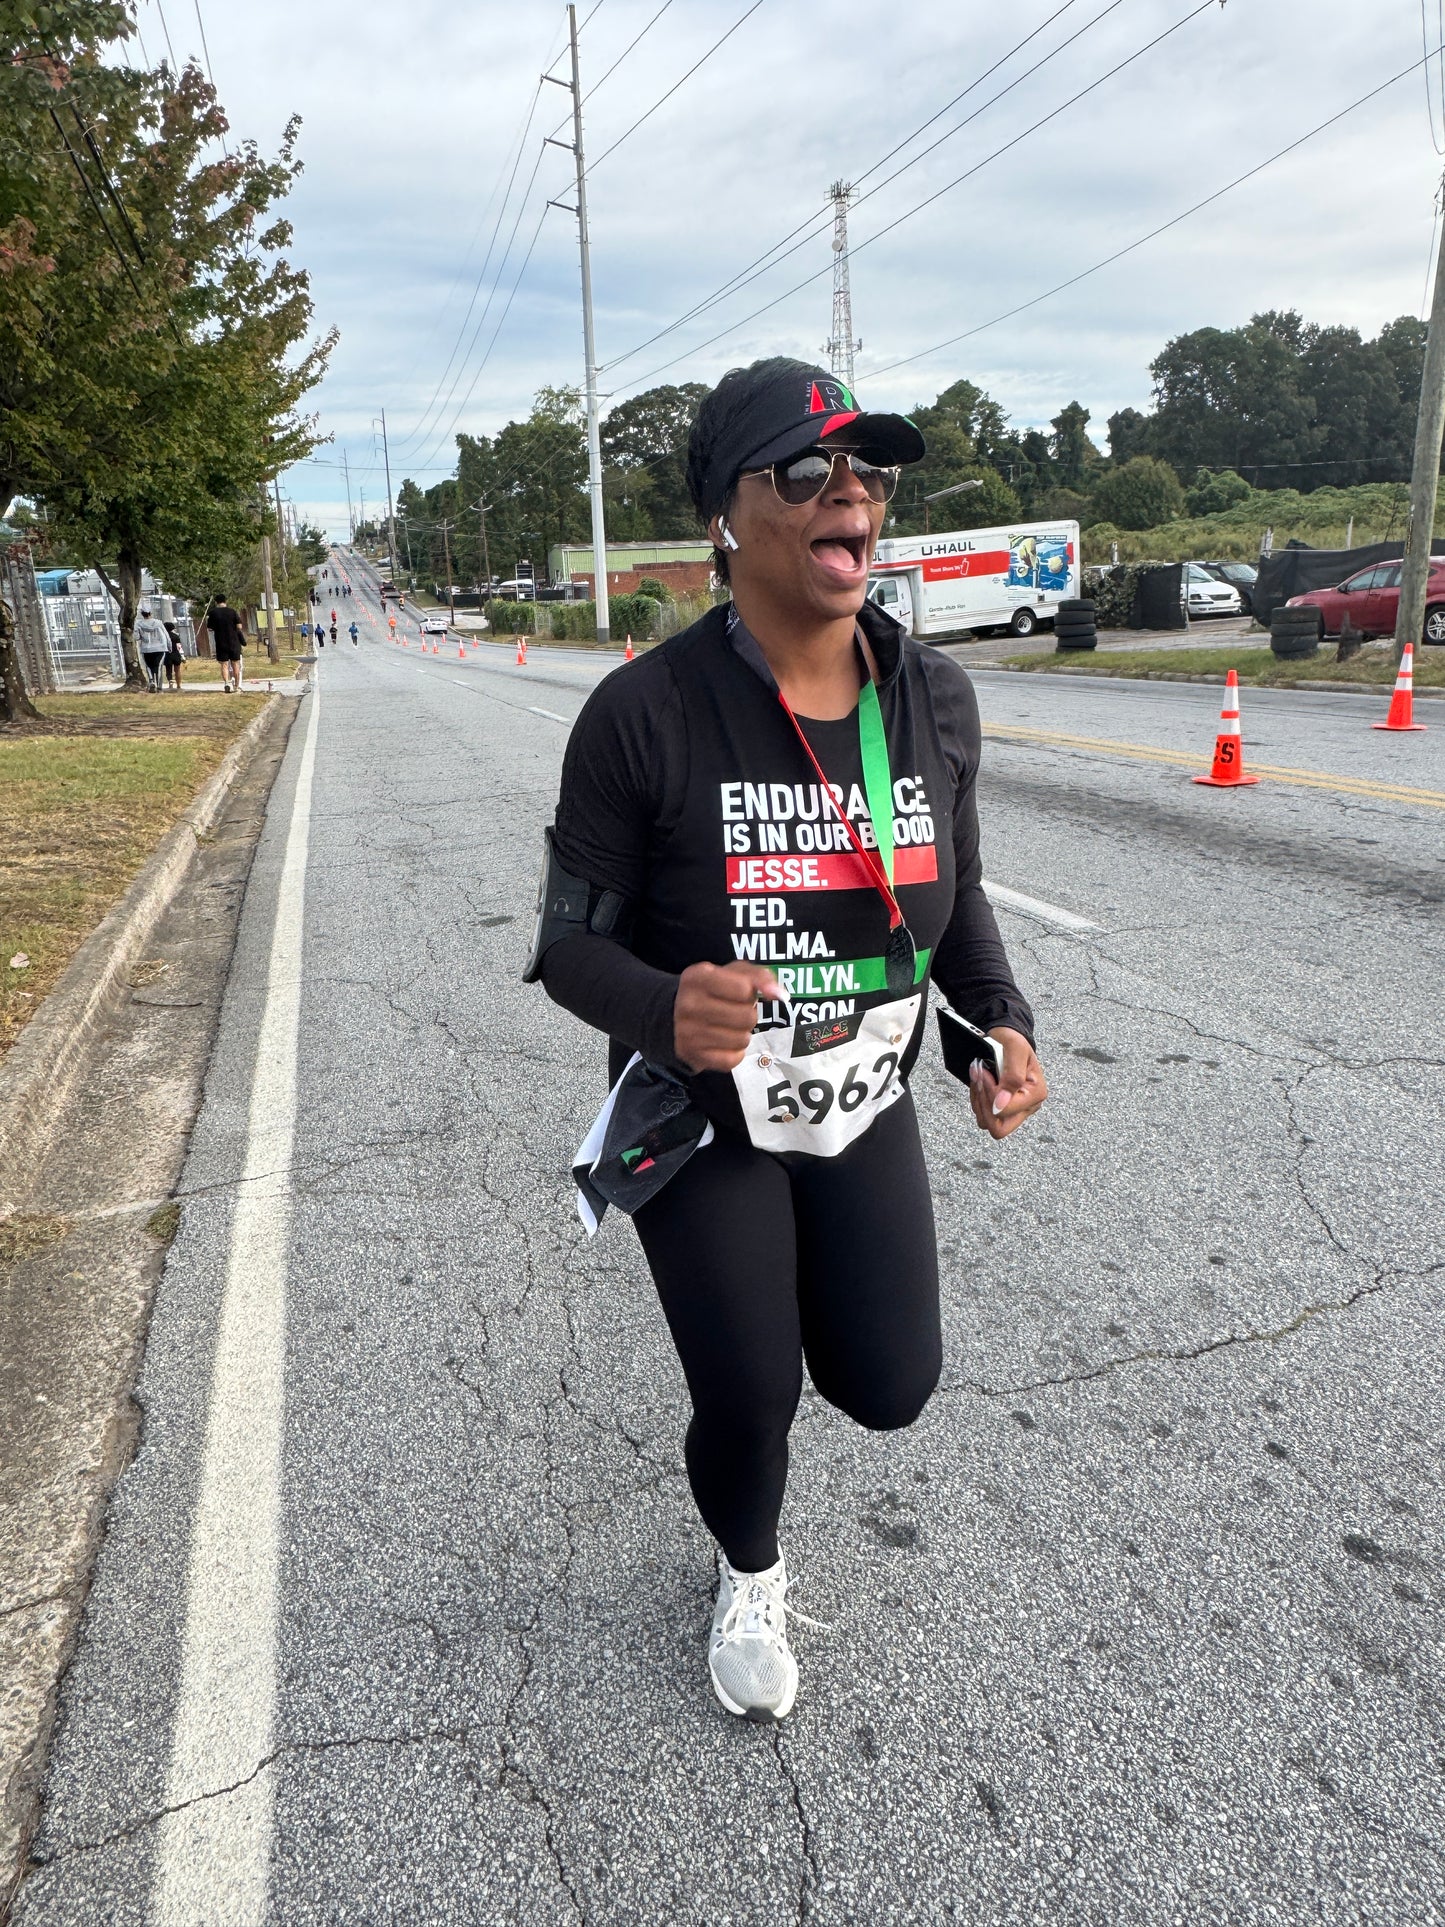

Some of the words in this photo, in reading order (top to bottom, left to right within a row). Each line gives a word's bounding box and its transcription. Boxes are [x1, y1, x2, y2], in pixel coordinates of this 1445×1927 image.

[921, 541, 976, 556] U-HAUL
[720, 776, 930, 821] ENDURACE
[724, 824, 751, 853] IS
[758, 823, 788, 851] IN
[796, 823, 853, 852] OUR
[859, 816, 935, 849] BOOD
[732, 859, 828, 890] JESSE.
[731, 898, 793, 928] TED.
[731, 931, 835, 960] WILMA.
[758, 964, 860, 994] RILYN.
[754, 999, 856, 1026] LLYSON
[766, 1051, 898, 1124] 5962
